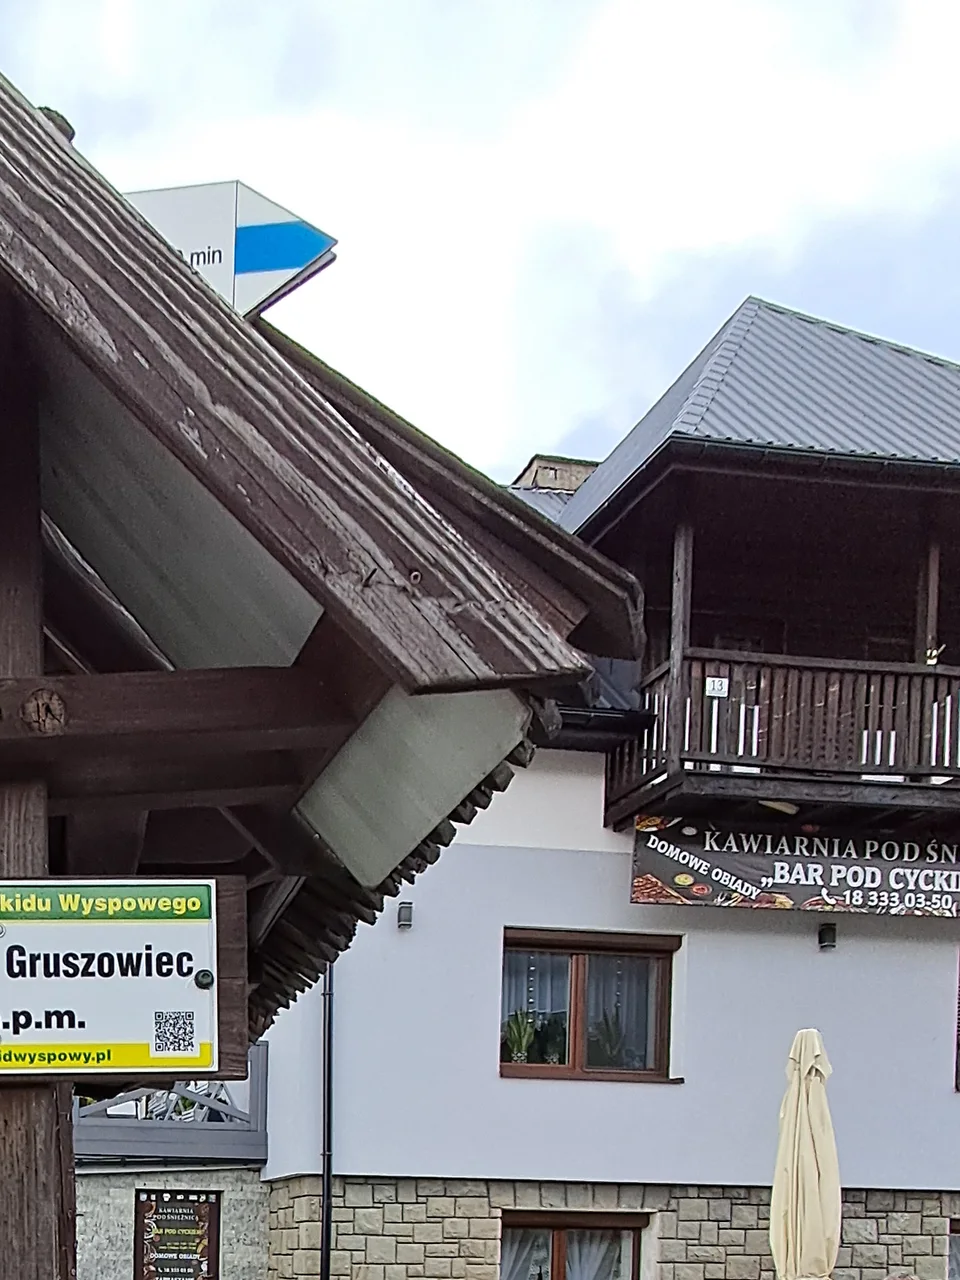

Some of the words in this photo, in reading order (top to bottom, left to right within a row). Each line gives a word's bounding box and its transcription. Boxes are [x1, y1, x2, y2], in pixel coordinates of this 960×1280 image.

[190, 245, 222, 266] min
[710, 679, 724, 691] 13
[704, 831, 858, 859] KAWIARNIA
[863, 840, 920, 862] POD
[646, 835, 711, 876] DOMOWE
[711, 867, 762, 900] OBIADY
[830, 865, 882, 889] POD
[58, 893, 201, 915] Wyspowego
[843, 890, 863, 906] 18
[867, 891, 900, 907] 333
[904, 892, 953, 909] 03-50
[6, 944, 194, 978] Gruszowiec
